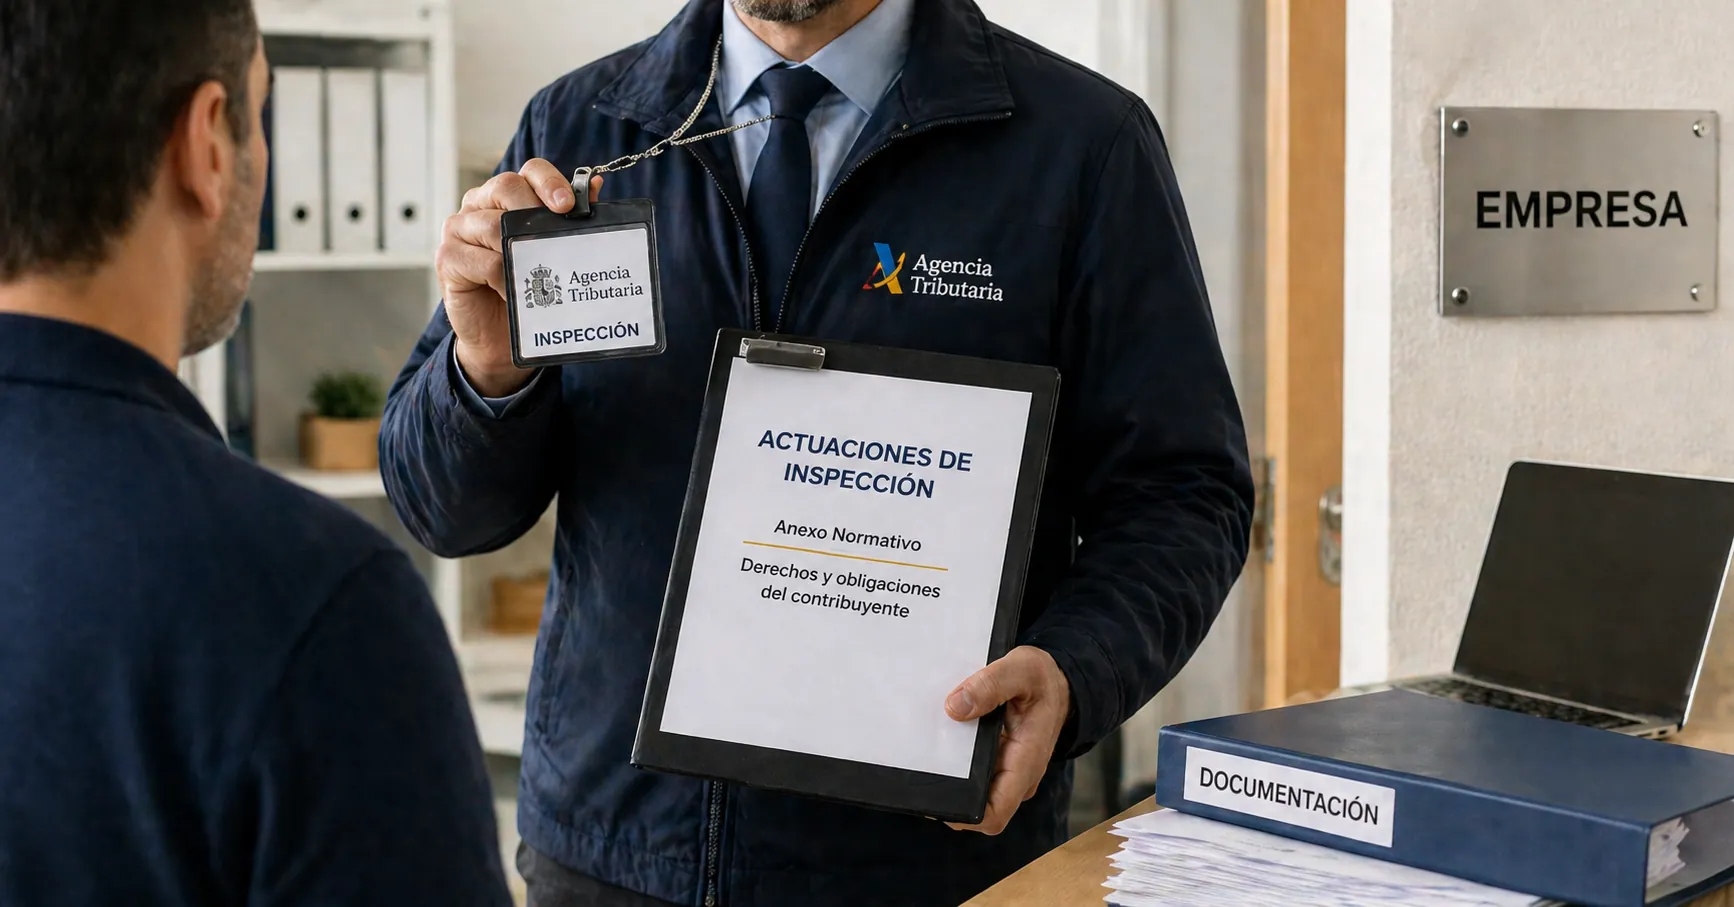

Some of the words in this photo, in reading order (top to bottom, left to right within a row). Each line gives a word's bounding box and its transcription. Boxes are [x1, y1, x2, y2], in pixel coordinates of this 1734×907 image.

[1476, 190, 1688, 229] EMPRESA
[568, 265, 631, 286] Agencia
[912, 253, 993, 277] Agencia
[567, 282, 644, 303] Tributaria
[910, 275, 1004, 302] Tributaria
[534, 321, 640, 347] INSPECCIÓN
[757, 429, 932, 467] ACTUACIONES
[938, 449, 973, 472] DE
[783, 462, 935, 499] INSPECCIÓN
[773, 519, 828, 540] Anexo
[831, 526, 922, 552] Normativo
[740, 557, 818, 581] Derechos
[821, 570, 833, 586] y
[836, 570, 941, 599] obligaciones
[760, 584, 787, 602] del
[790, 588, 910, 618] contribuyente
[1199, 766, 1379, 826] DOCUMENTACIÓN
